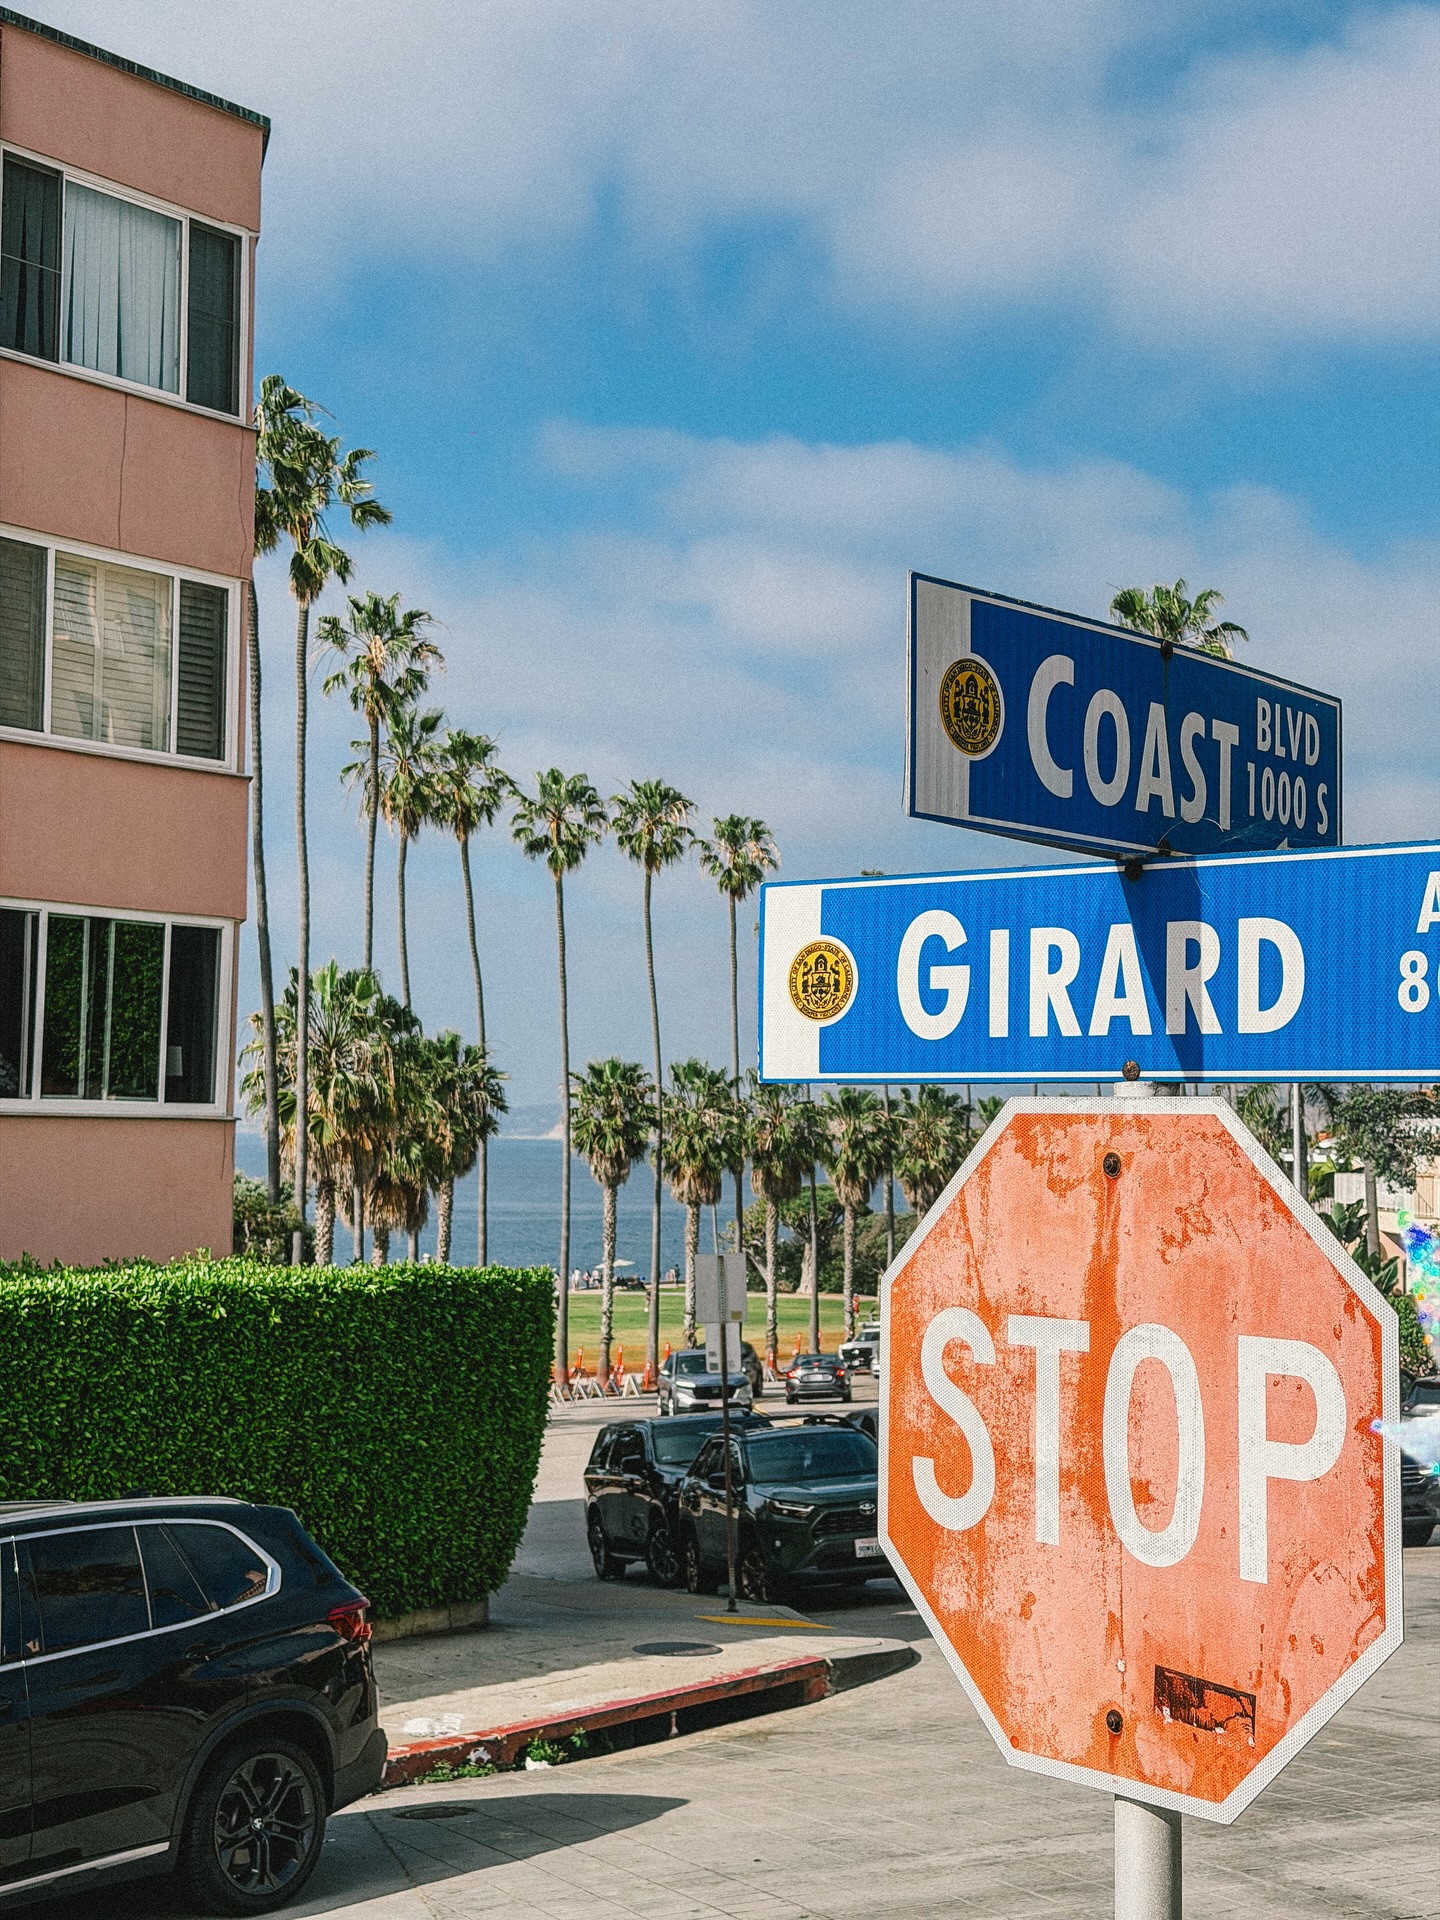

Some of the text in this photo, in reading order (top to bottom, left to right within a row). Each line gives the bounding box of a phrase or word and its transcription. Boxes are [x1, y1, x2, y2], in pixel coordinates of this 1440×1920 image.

[1027, 654, 1239, 831] COAST
[1257, 697, 1320, 766] BLVD
[1247, 761, 1329, 835] 1000 S
[897, 909, 1305, 1040] GIRARD
[1398, 950, 1440, 1013] 8
[912, 1306, 1347, 1584] STOP
